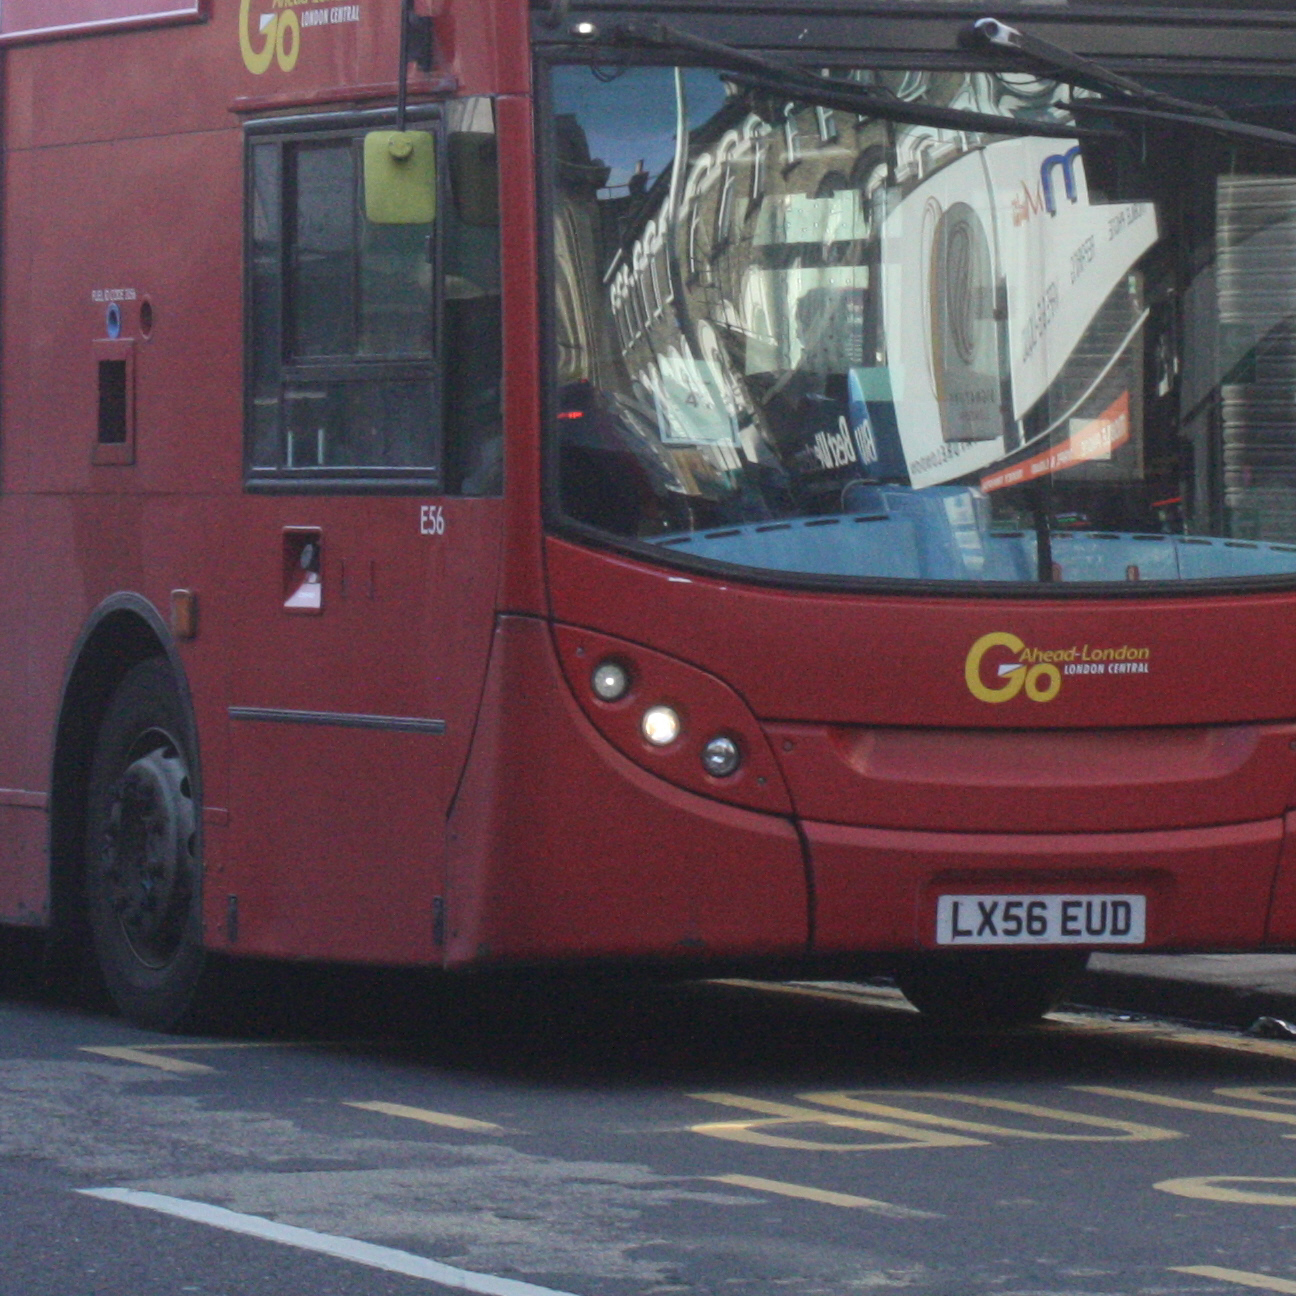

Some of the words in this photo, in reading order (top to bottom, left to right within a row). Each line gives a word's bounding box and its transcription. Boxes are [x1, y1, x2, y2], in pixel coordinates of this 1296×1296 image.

[301, 7, 329, 27] LONDON
[330, 5, 360, 23] CENTRAL
[420, 506, 444, 535] E56
[1019, 643, 1150, 663] Ahead-London
[1064, 662, 1104, 676] LONDON
[1108, 660, 1150, 674] CENTRAL
[950, 900, 1048, 938] LX56
[1060, 900, 1132, 938] EUD
